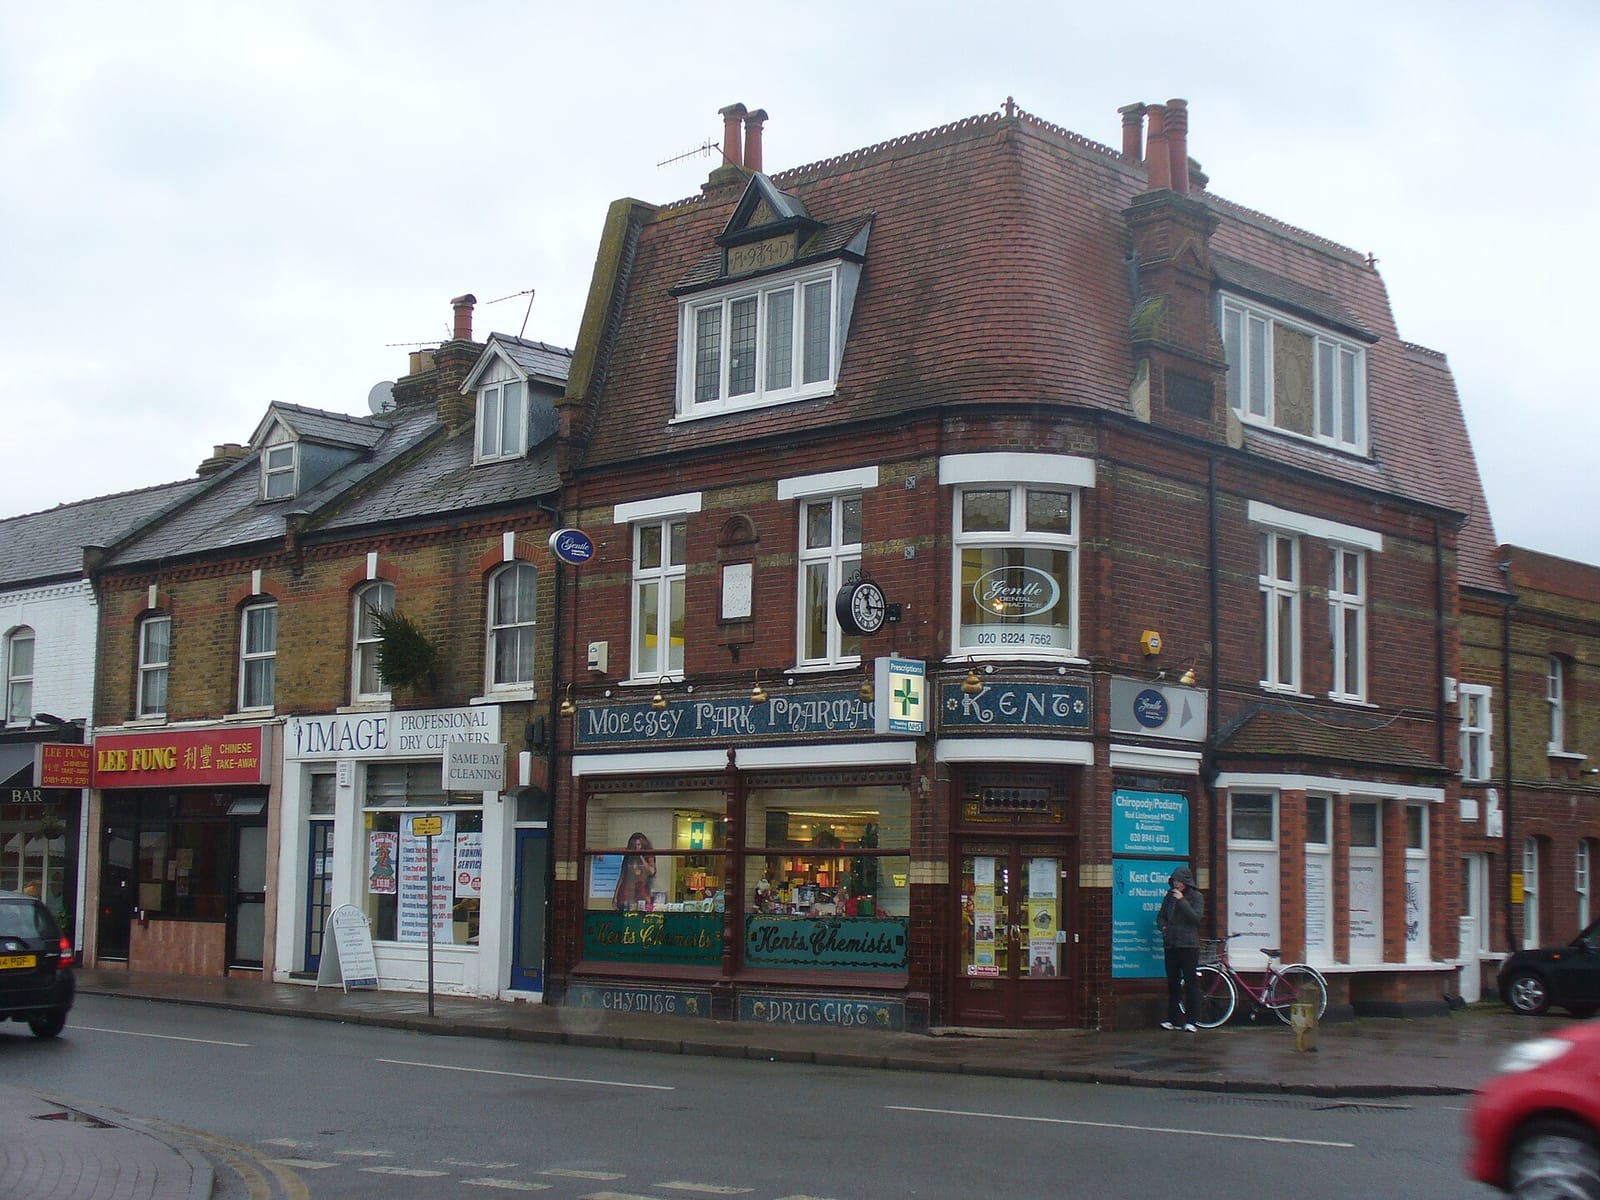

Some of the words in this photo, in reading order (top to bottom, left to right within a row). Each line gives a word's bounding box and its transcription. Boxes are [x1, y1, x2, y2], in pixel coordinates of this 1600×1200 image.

[560, 535, 589, 550] Gentle
[983, 580, 1042, 600] Gentle
[978, 633, 996, 644] 020
[1001, 633, 1025, 644] 8224
[1030, 634, 1051, 645] 7562
[890, 663, 922, 673] Prescriptions
[961, 687, 1070, 723] KENT
[401, 712, 488, 730] PROFESSIONAL
[588, 708, 684, 737] MOLESEY
[694, 703, 755, 736] PARK
[768, 698, 876, 732] PHARMAC
[908, 722, 921, 731] NHS
[306, 718, 388, 752] IMAGE
[400, 734, 422, 750] DRY
[427, 732, 489, 749] CLEANERS
[45, 748, 61, 758] LEE
[65, 748, 89, 758] FUNG
[219, 743, 252, 754] CHINESE
[97, 750, 129, 772] LEE
[131, 747, 177, 770] FUNG
[216, 758, 257, 769] TAKE-AWAY
[452, 753, 479, 764] SAME
[482, 754, 500, 765] DAY
[450, 769, 501, 779] CLEANING
[12, 790, 42, 802] BAR
[459, 848, 482, 857] IRONIN
[458, 860, 482, 869] SERVIC
[1130, 871, 1148, 882] Kent
[755, 926, 808, 953] Kents
[810, 927, 896, 956] Chemists
[602, 992, 676, 1014] CHYMIST
[766, 1001, 869, 1026] DRUGGIST
